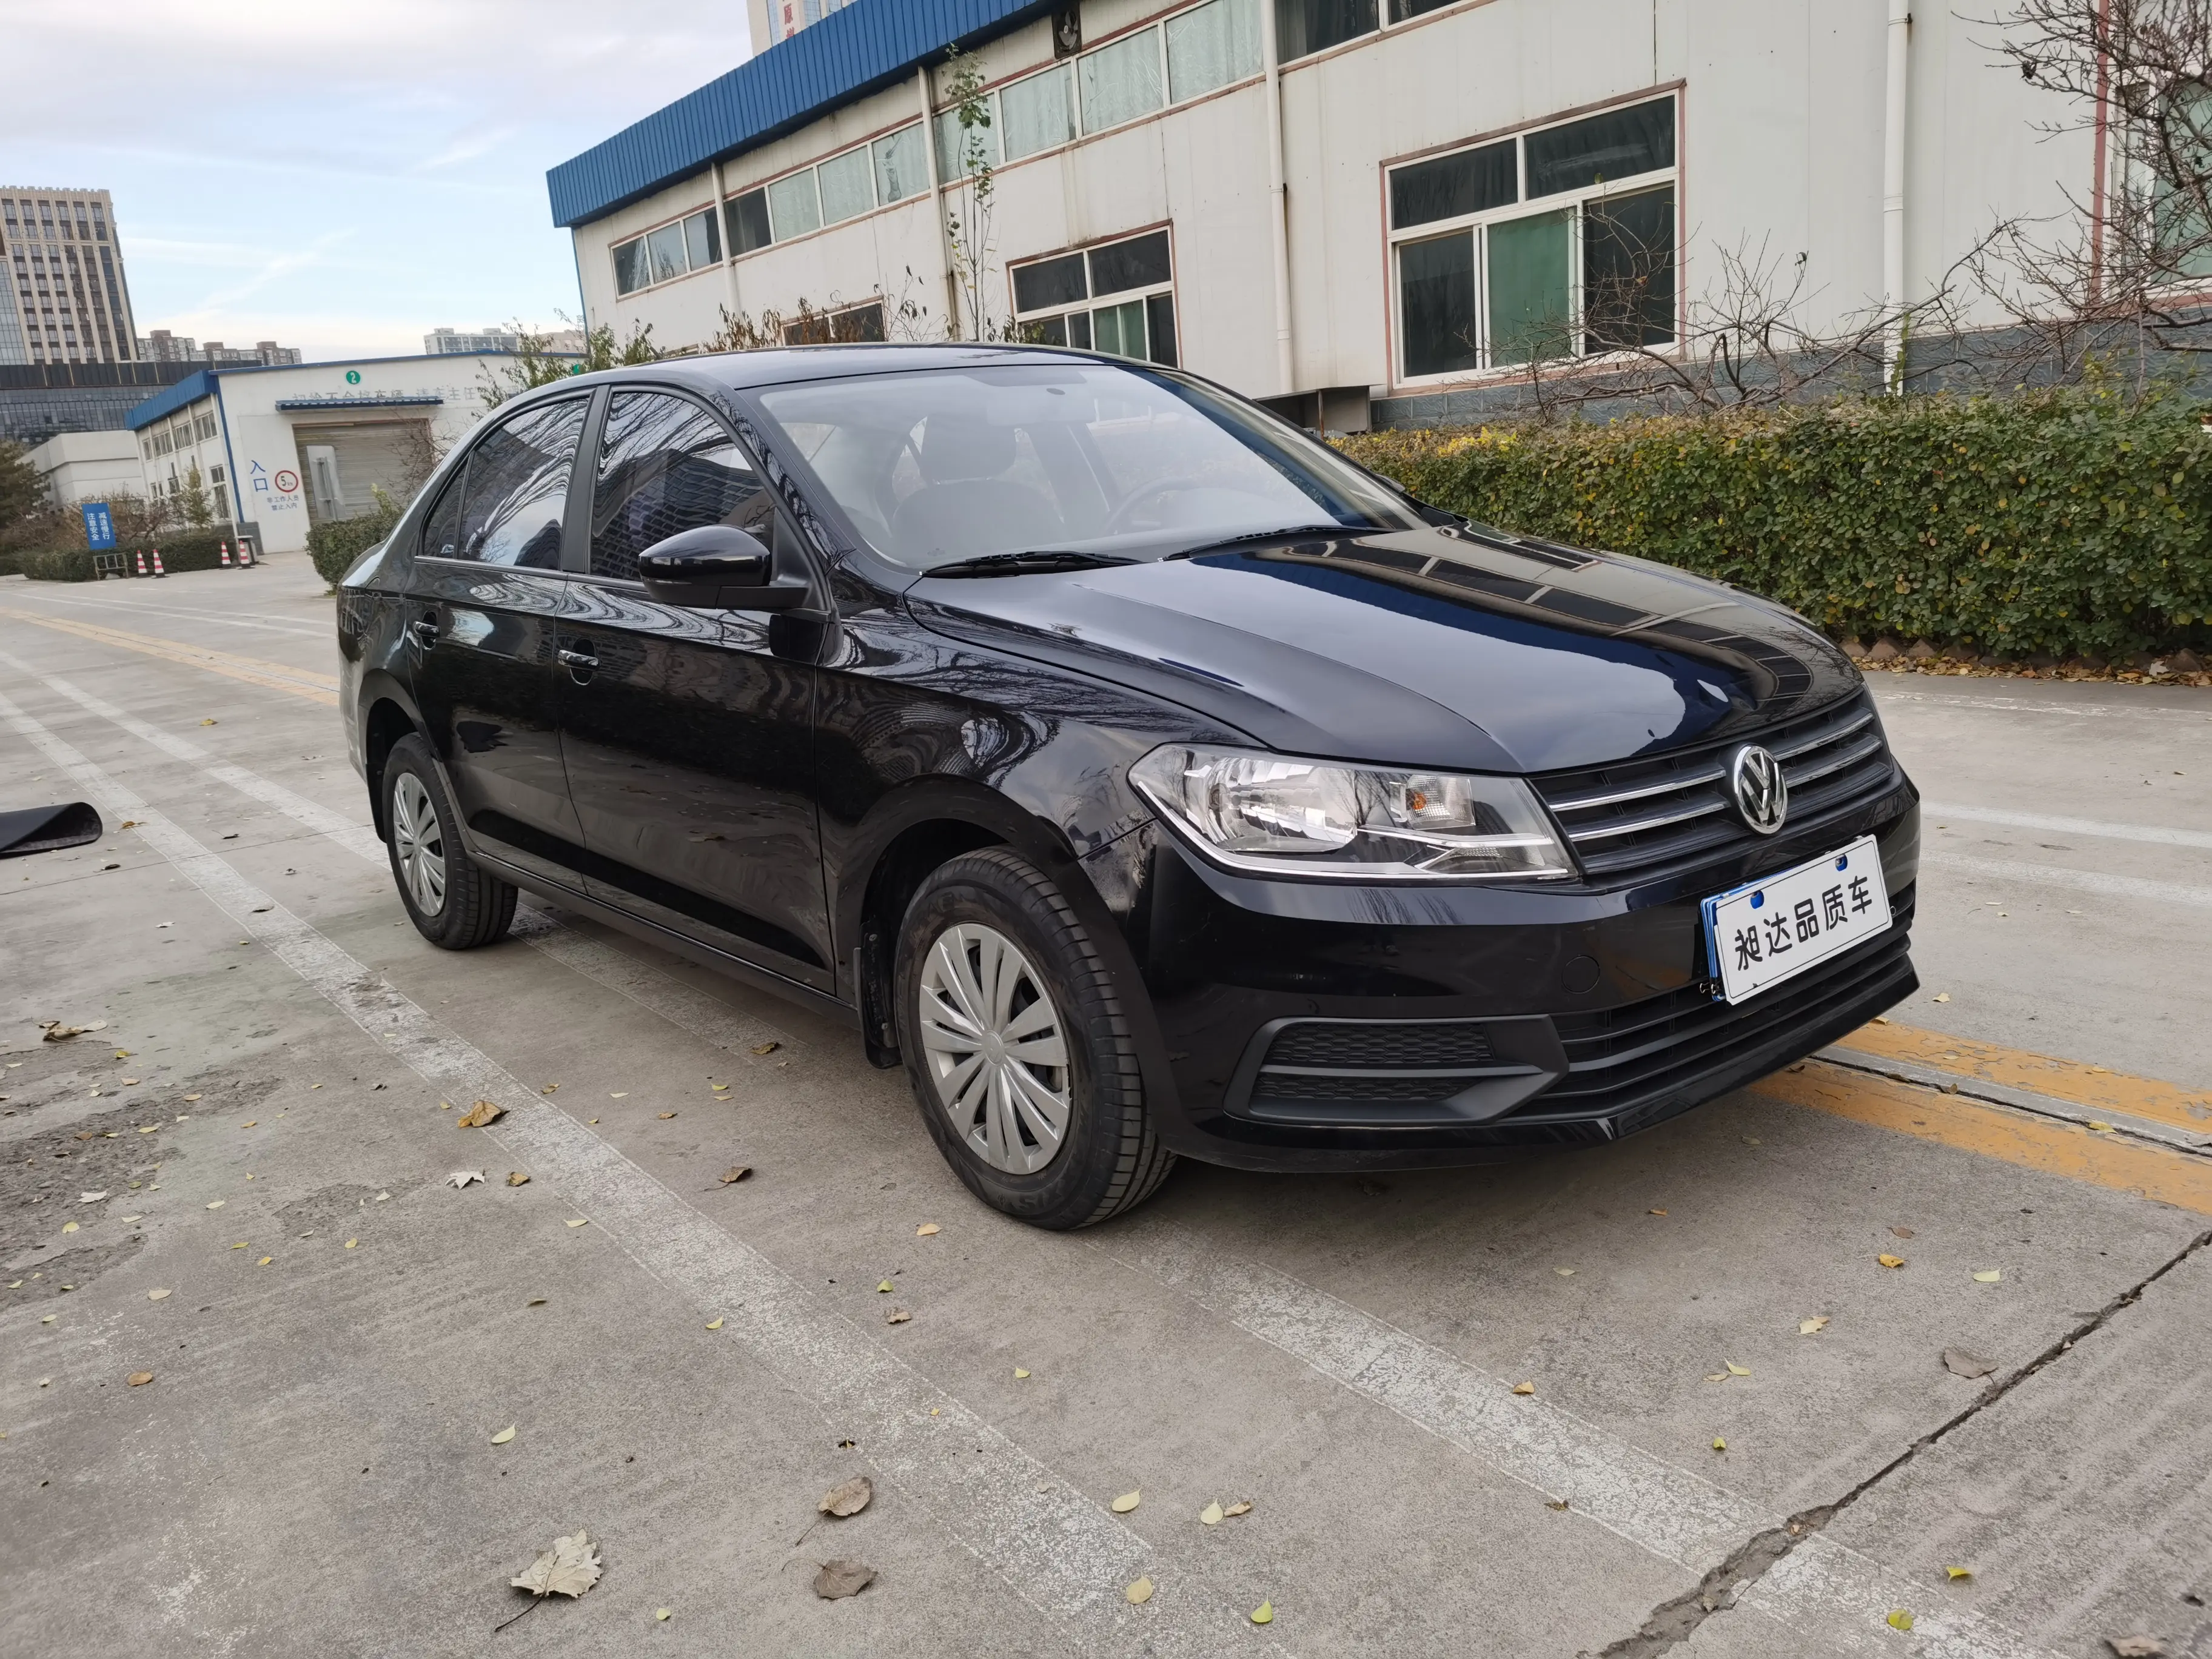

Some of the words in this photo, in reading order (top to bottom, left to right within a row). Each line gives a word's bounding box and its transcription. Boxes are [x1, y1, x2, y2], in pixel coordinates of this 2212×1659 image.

[350, 372, 357, 383] 2
[250, 460, 269, 492] 入口
[281, 475, 287, 487] 5
[87, 513, 99, 541] 注意安全
